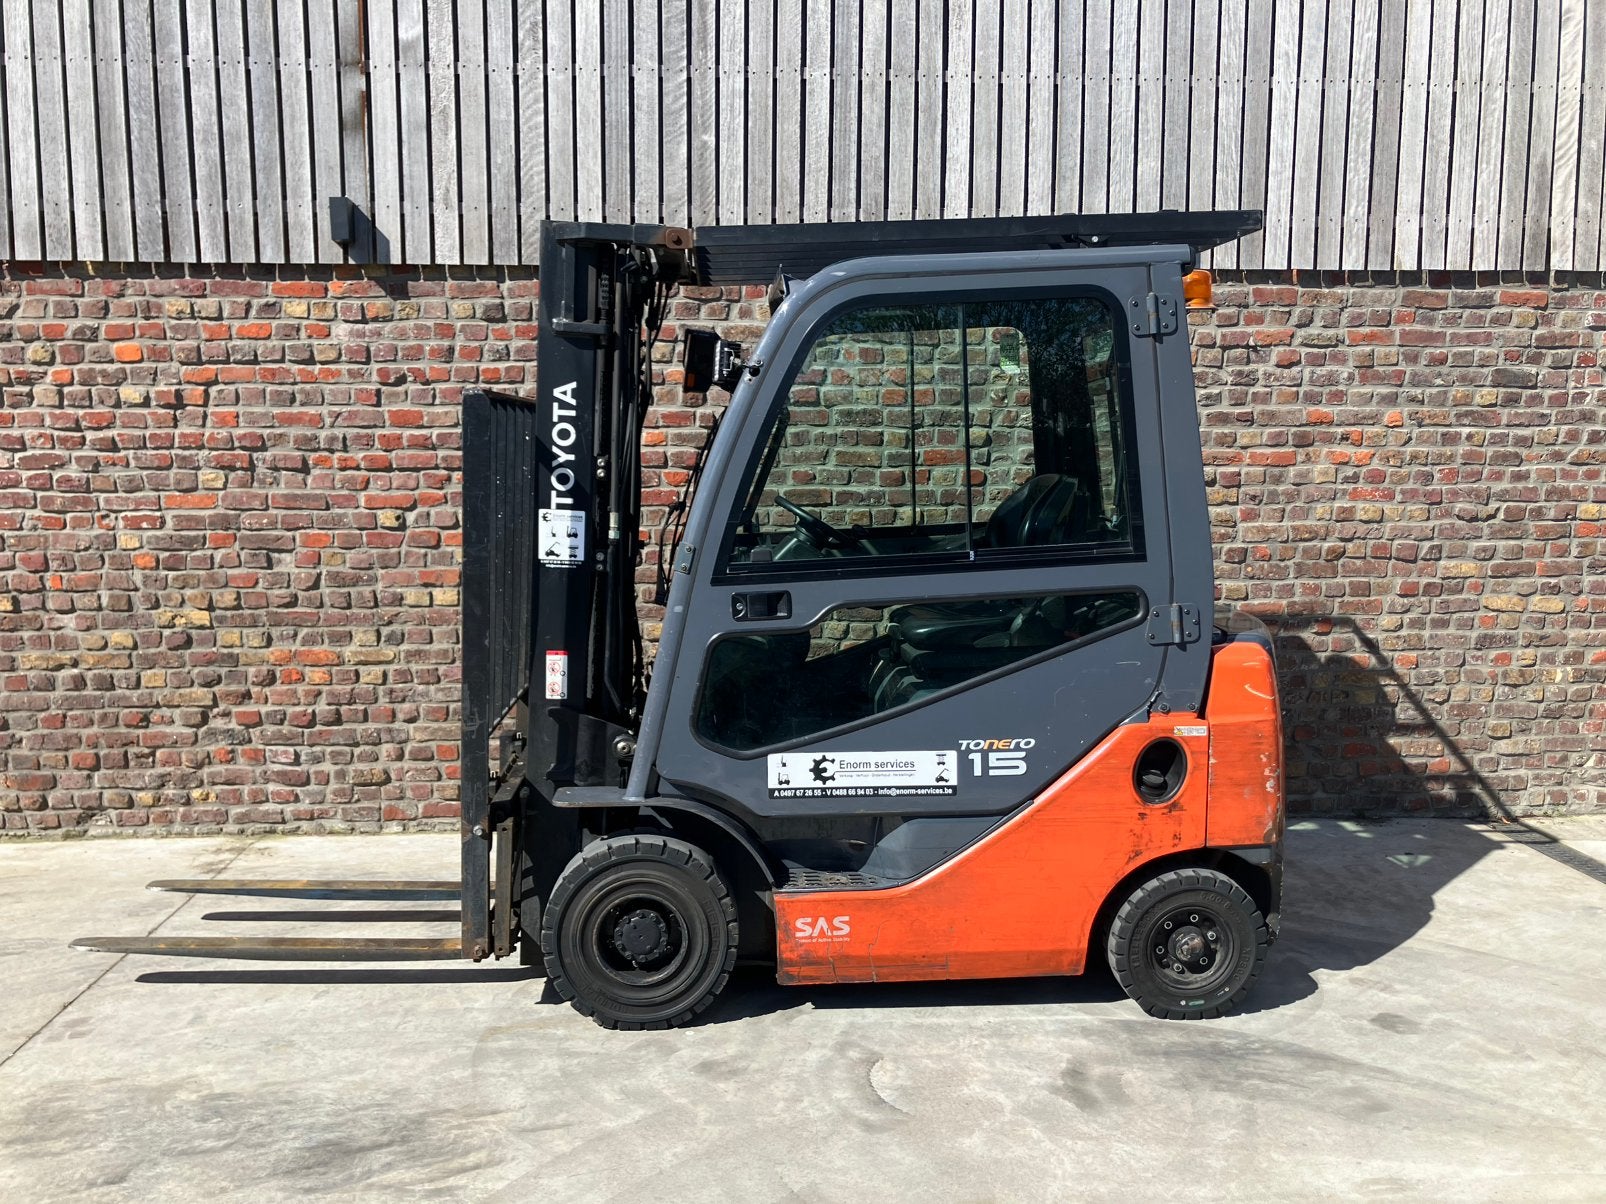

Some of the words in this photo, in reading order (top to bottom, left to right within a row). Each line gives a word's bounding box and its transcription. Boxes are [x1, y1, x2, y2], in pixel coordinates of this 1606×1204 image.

[550, 381, 577, 509] TOYOTA
[959, 738, 1036, 751] TONERO
[839, 759, 872, 770] Enorm
[874, 758, 915, 769] services
[968, 751, 1027, 777] 15
[773, 789, 780, 797] A
[780, 789, 794, 797] 0497
[796, 788, 804, 797] 67
[804, 788, 813, 796] 26
[813, 788, 822, 796] 55
[826, 788, 832, 796] V
[865, 787, 874, 795] 03
[878, 786, 953, 796] info@enorm-services.be
[794, 915, 851, 938] SAS
